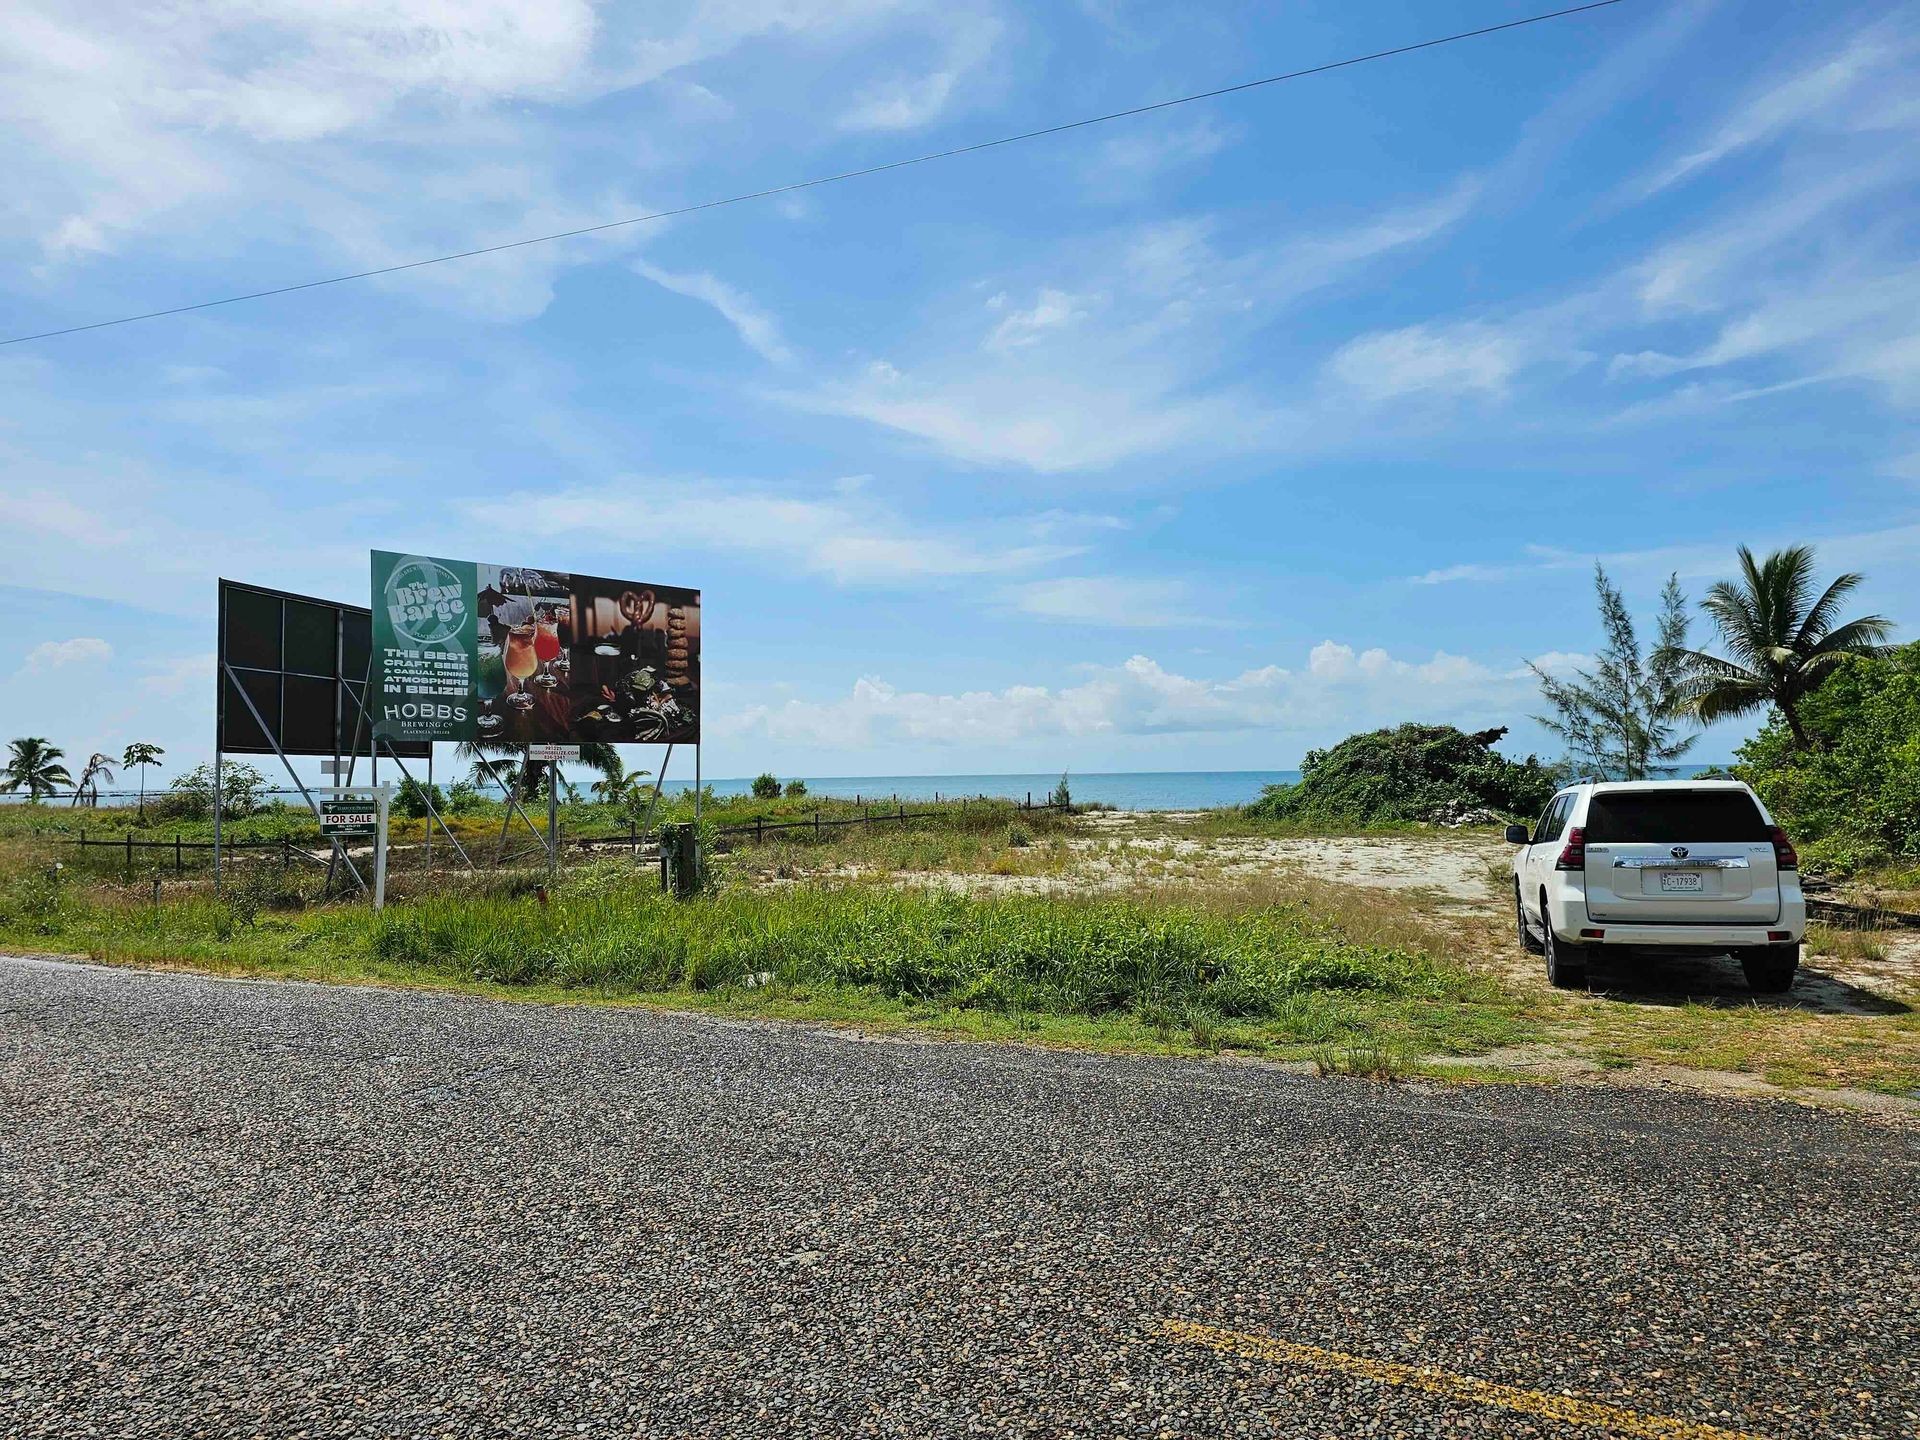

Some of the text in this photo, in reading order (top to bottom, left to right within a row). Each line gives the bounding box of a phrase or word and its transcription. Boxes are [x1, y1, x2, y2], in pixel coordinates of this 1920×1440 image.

[408, 581, 429, 590] The
[394, 584, 462, 606] Brew
[387, 598, 465, 624] Barge
[384, 648, 469, 662] THE BEST
[384, 659, 468, 670] CRAFT BEER
[394, 668, 435, 676] CASUAL
[384, 676, 469, 686] ATMOSPHERE
[384, 684, 469, 696] IN BELIZE!
[384, 703, 469, 722] HOBBS
[326, 814, 372, 824] FOR SALE
[1667, 877, 1697, 886] C-17938
